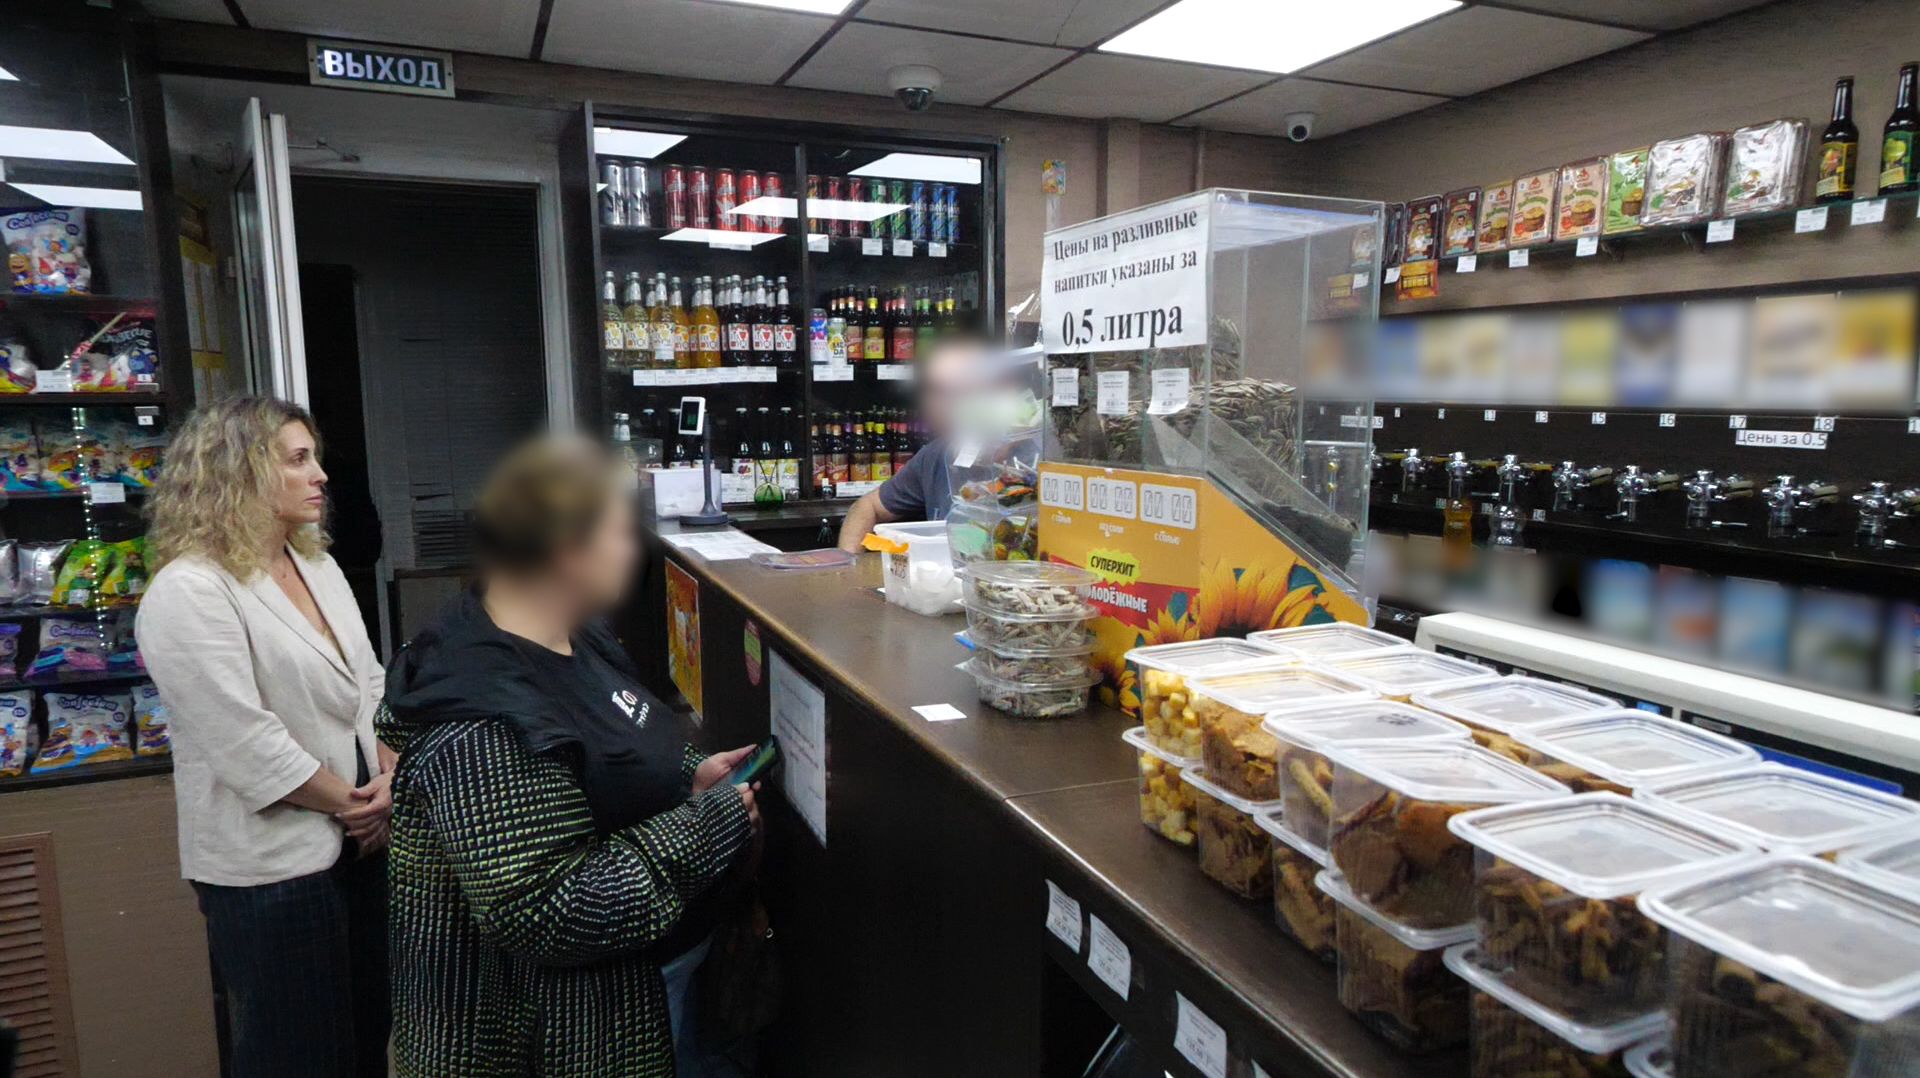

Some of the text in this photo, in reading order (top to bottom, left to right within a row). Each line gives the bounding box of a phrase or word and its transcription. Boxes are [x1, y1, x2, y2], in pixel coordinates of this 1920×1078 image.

[323, 49, 441, 89] ВЫХОД
[1054, 210, 1197, 261] Цены на разливные
[1054, 250, 1197, 293] напитки указаны за
[1062, 305, 1183, 349] 0,5 литра
[1536, 412, 1548, 423] 13
[1592, 413, 1605, 424] 15
[1661, 415, 1675, 426] 16
[1730, 416, 1747, 428] 17
[1816, 418, 1834, 431] 18
[1736, 432, 1827, 446] Цены за 0.5
[1090, 556, 1136, 577] СУПЕРХИТ
[1085, 585, 1149, 613] ОЛОДЁЖНЫЕ
